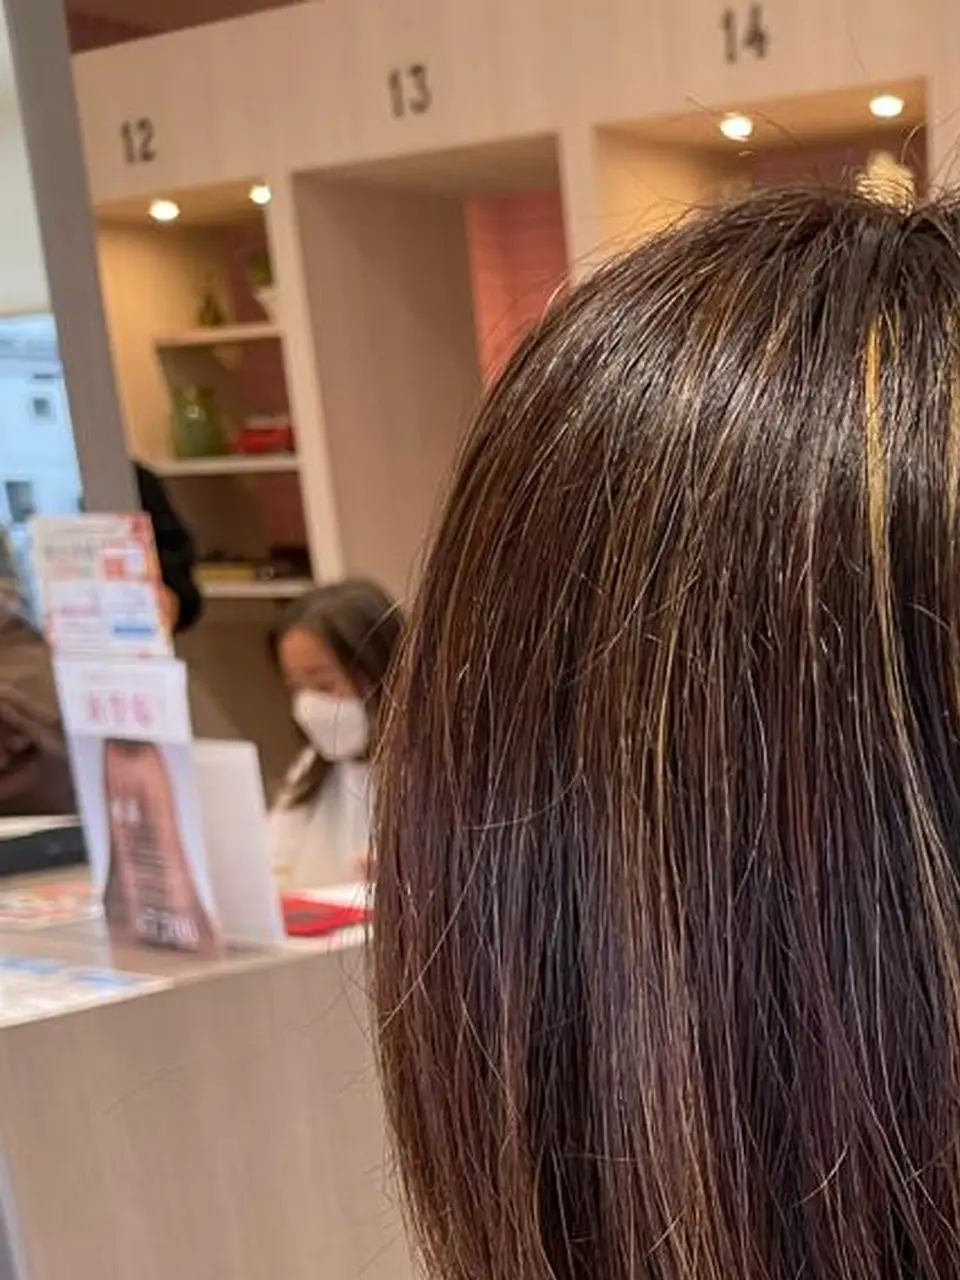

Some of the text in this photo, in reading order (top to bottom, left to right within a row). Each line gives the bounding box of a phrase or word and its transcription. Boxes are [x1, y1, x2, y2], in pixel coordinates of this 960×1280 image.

[720, 5, 770, 63] 14
[388, 64, 433, 117] 13
[120, 117, 157, 164] 12
